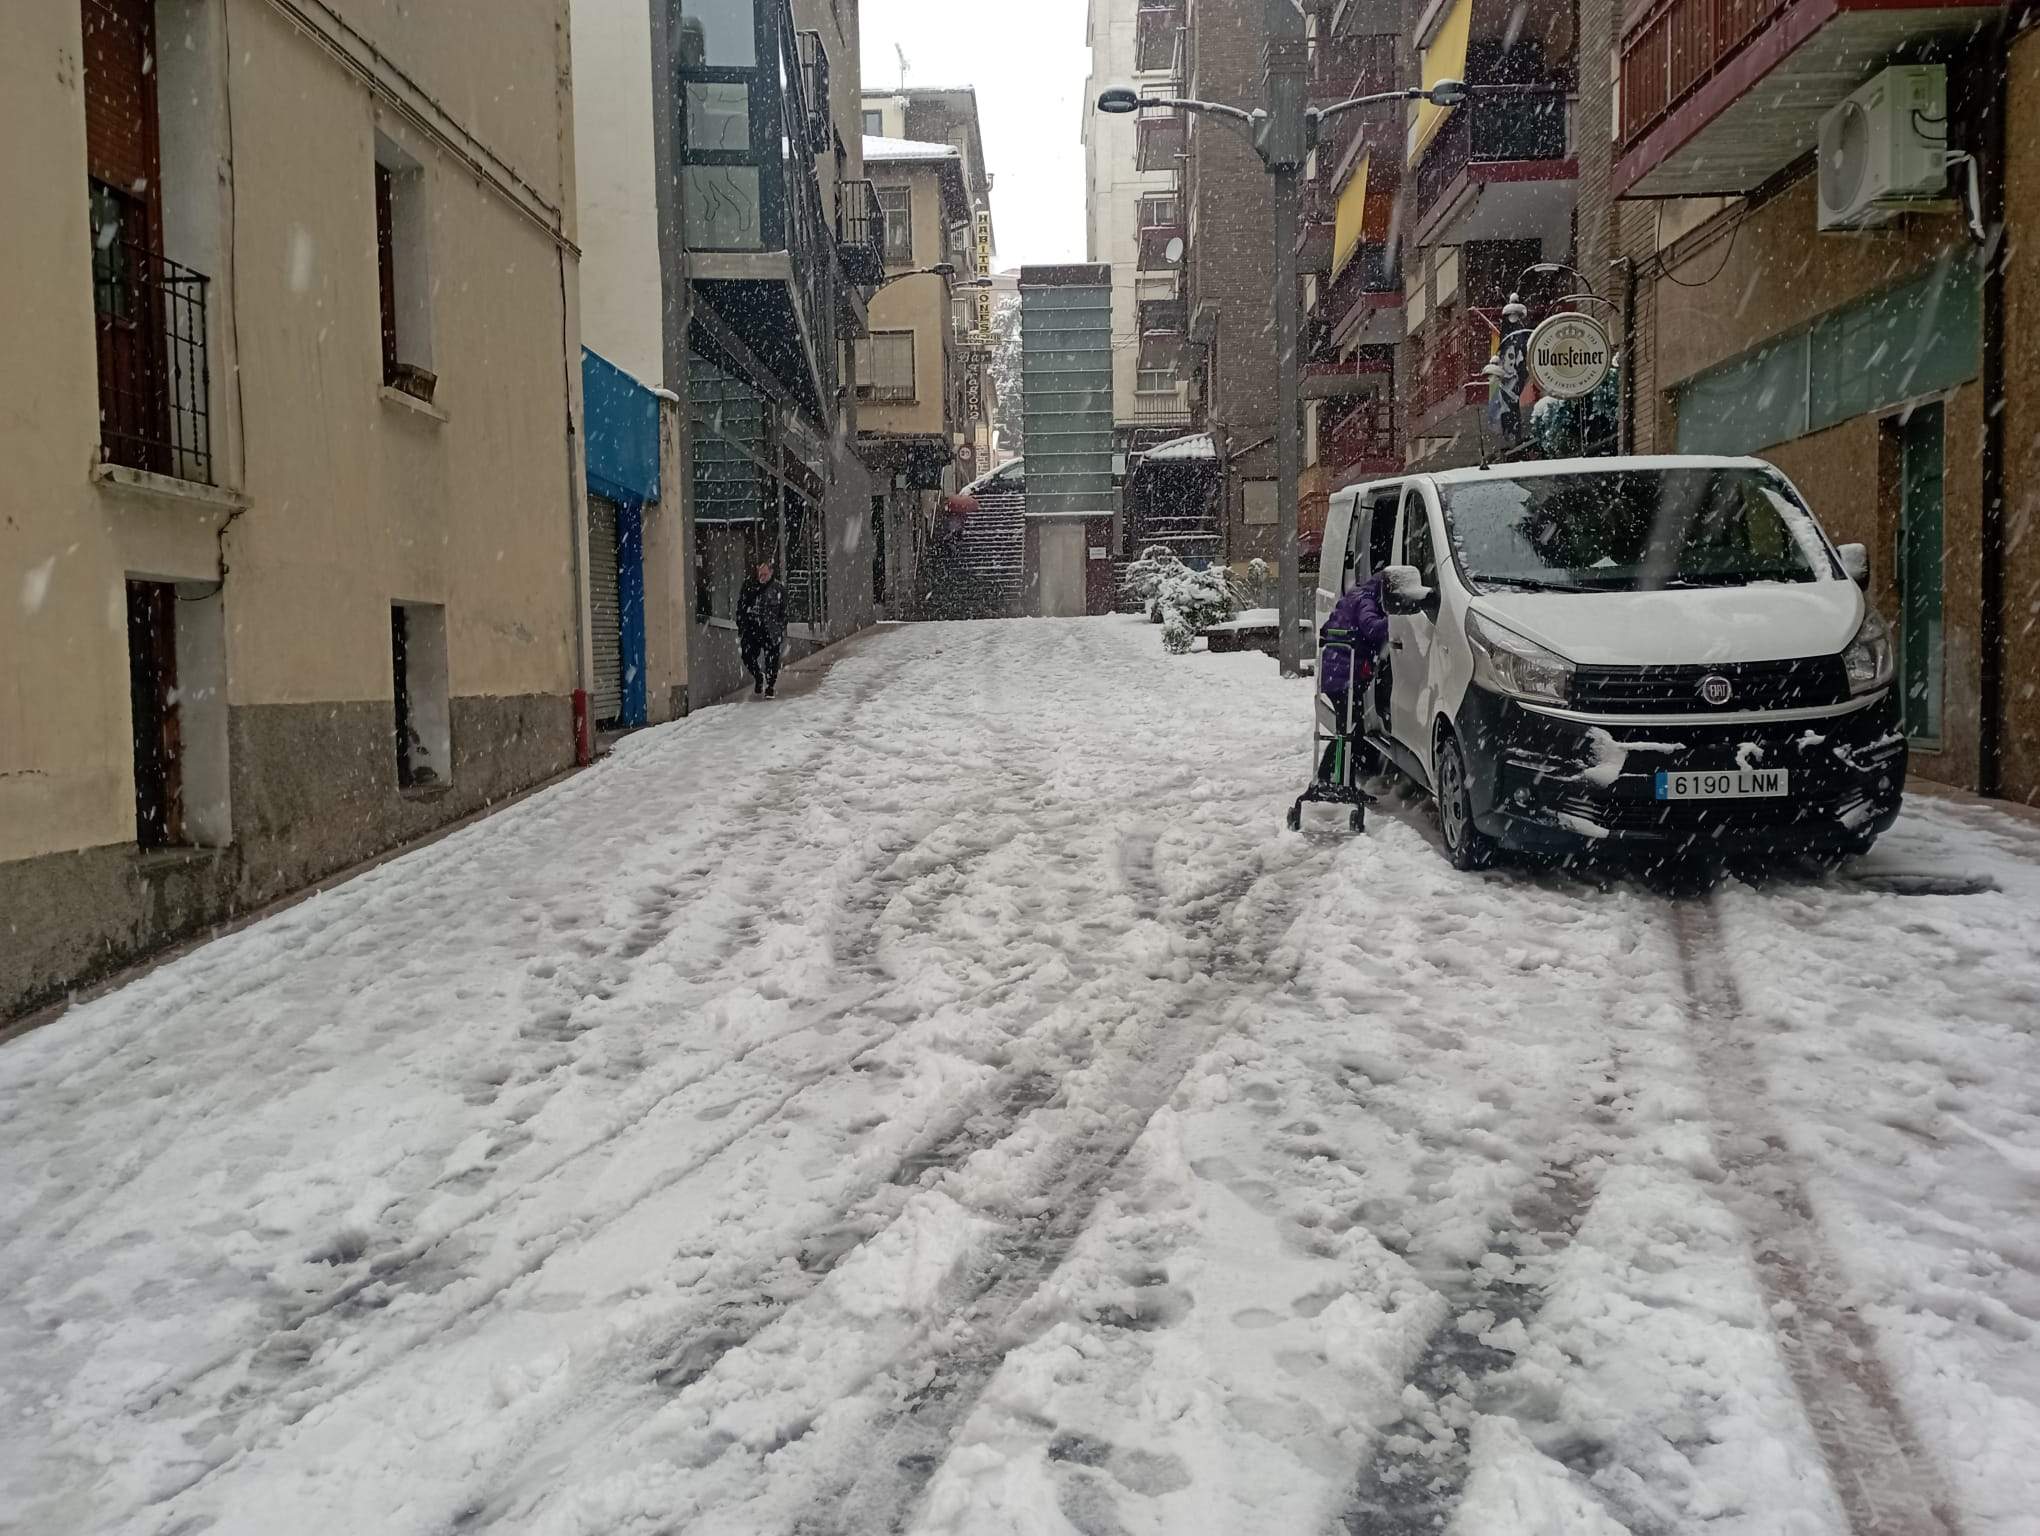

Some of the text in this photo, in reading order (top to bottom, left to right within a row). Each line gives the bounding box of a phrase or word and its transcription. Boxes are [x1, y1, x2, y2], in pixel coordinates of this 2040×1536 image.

[977, 213, 991, 335] HABITAONES
[1537, 346, 1604, 368] Warsteiner
[1709, 684, 1726, 697] FIAT
[1675, 775, 1731, 795] 6190
[1738, 773, 1779, 793] LNM
